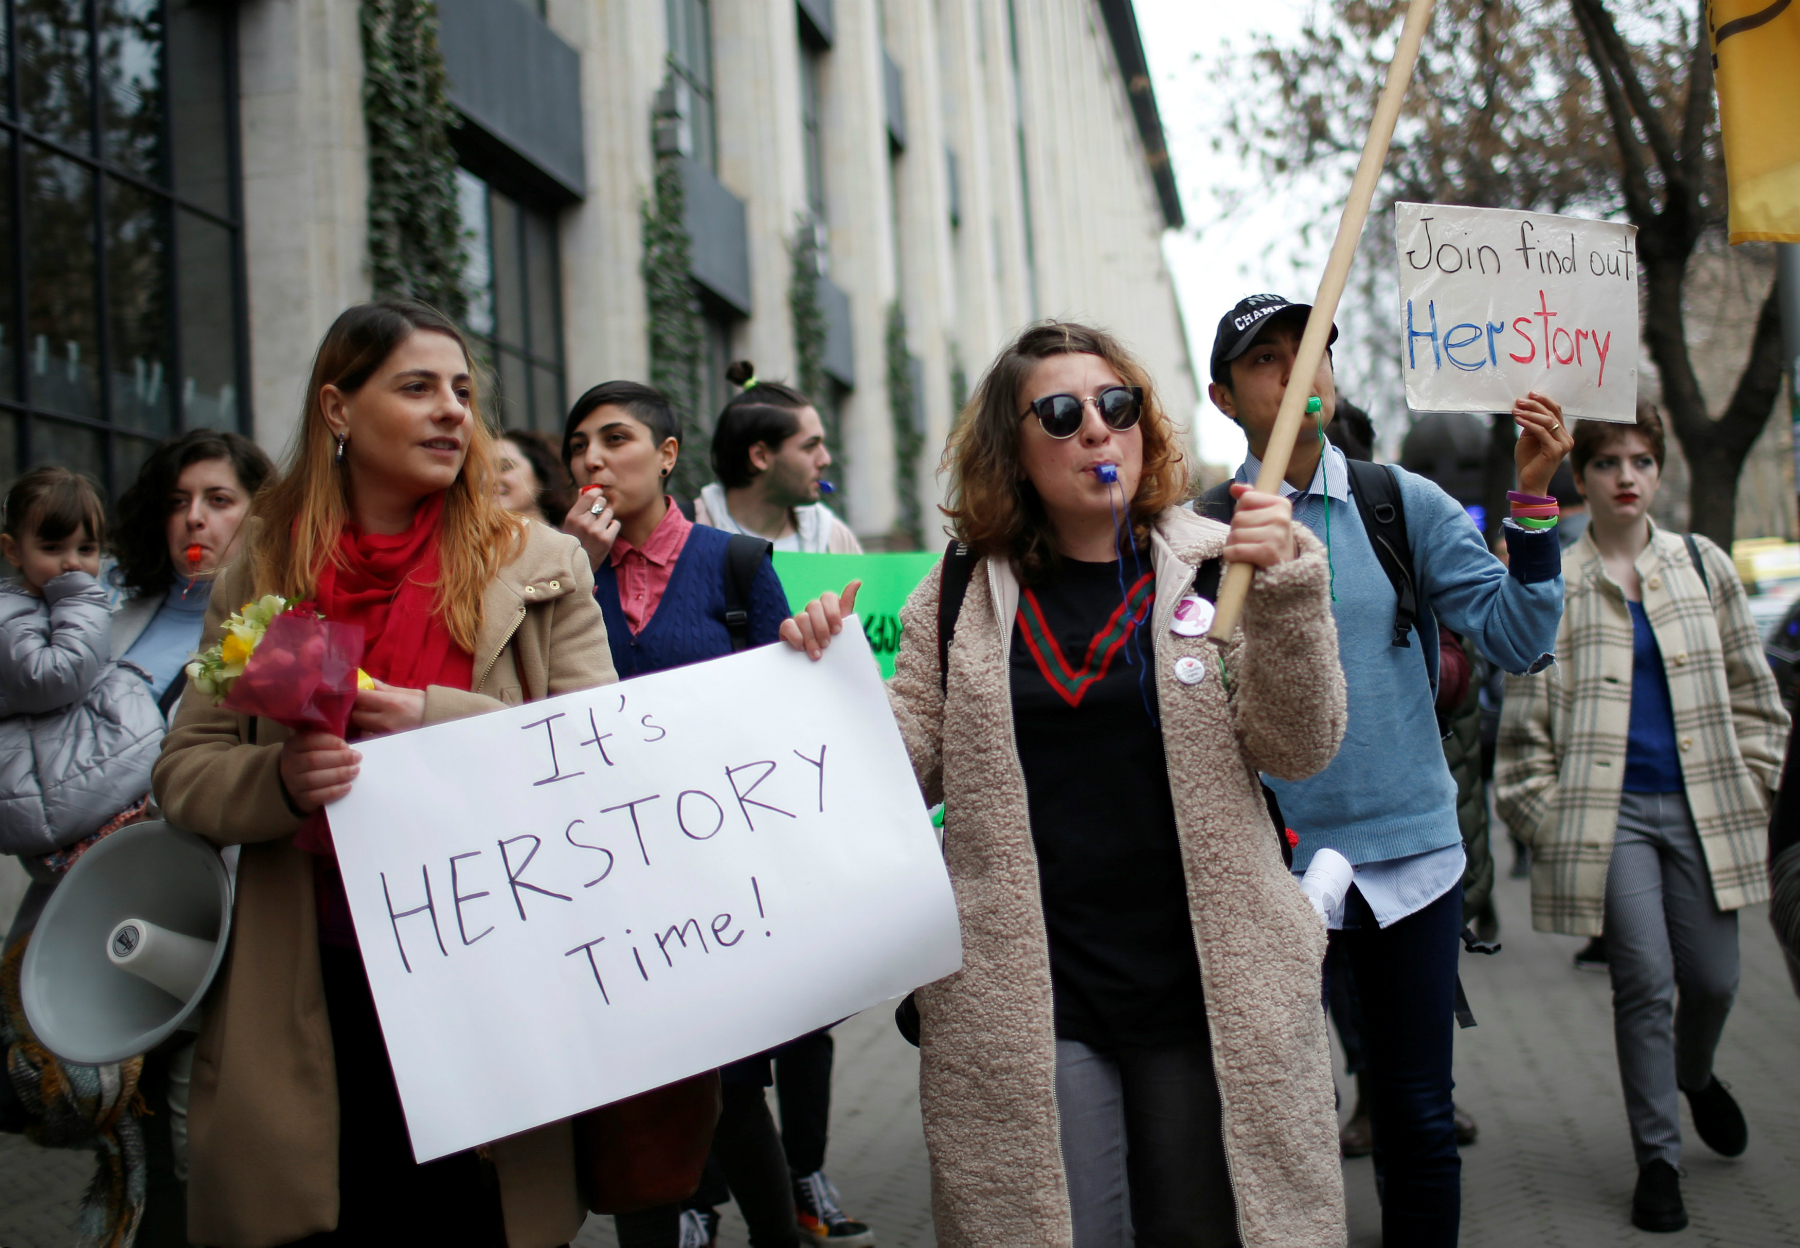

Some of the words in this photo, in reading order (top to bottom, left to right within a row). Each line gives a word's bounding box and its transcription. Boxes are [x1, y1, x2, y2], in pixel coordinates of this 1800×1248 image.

[1406, 217, 1501, 275] Join
[1514, 220, 1577, 275] find
[1590, 234, 1634, 281] out
[1234, 304, 1287, 331] CHAMP
[1406, 289, 1612, 388] Herstory
[520, 693, 668, 787] It's
[379, 744, 828, 974] HERSTORY
[564, 875, 772, 1006] Time!
